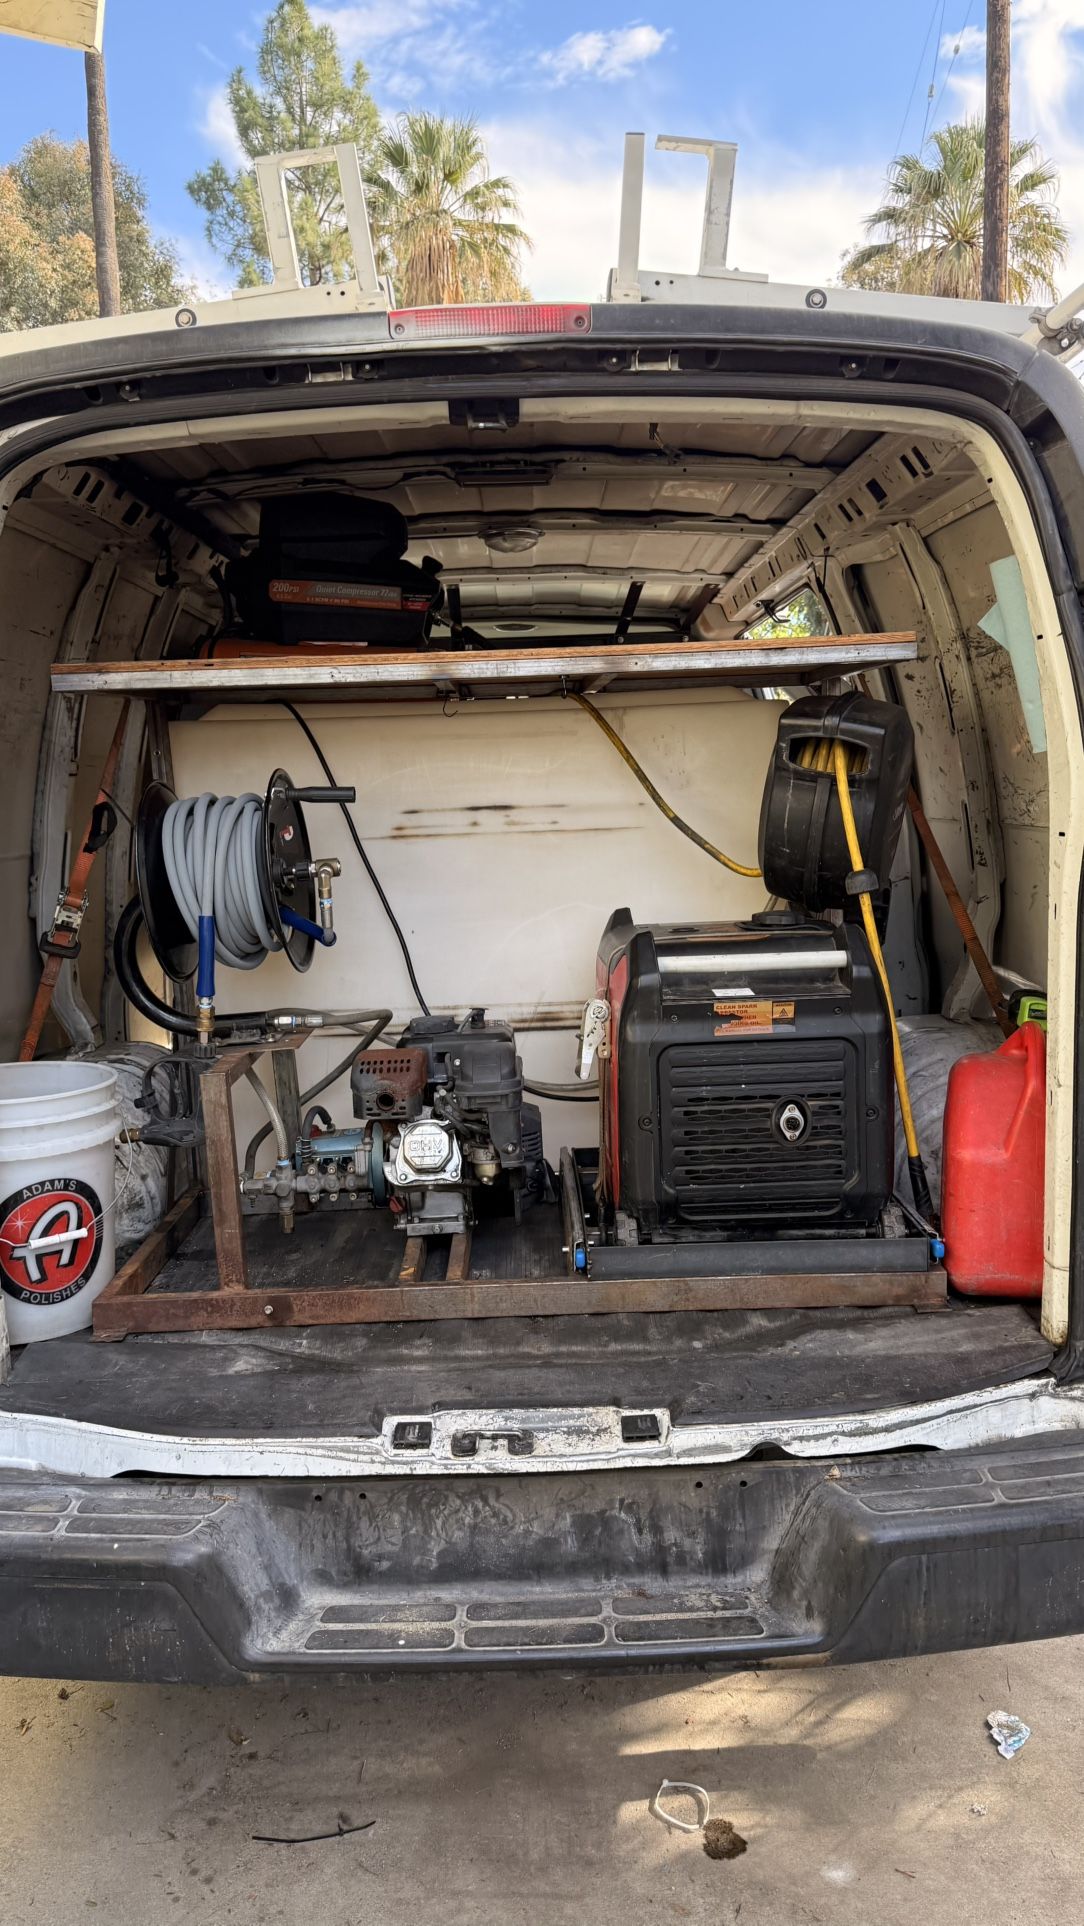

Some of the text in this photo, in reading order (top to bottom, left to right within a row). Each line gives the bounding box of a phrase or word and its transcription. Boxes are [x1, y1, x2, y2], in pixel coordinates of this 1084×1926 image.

[337, 585, 380, 597] Compressor
[410, 1138, 443, 1152] OHV
[22, 1179, 78, 1200] ADAM'S
[20, 1276, 86, 1304] POLISHES
